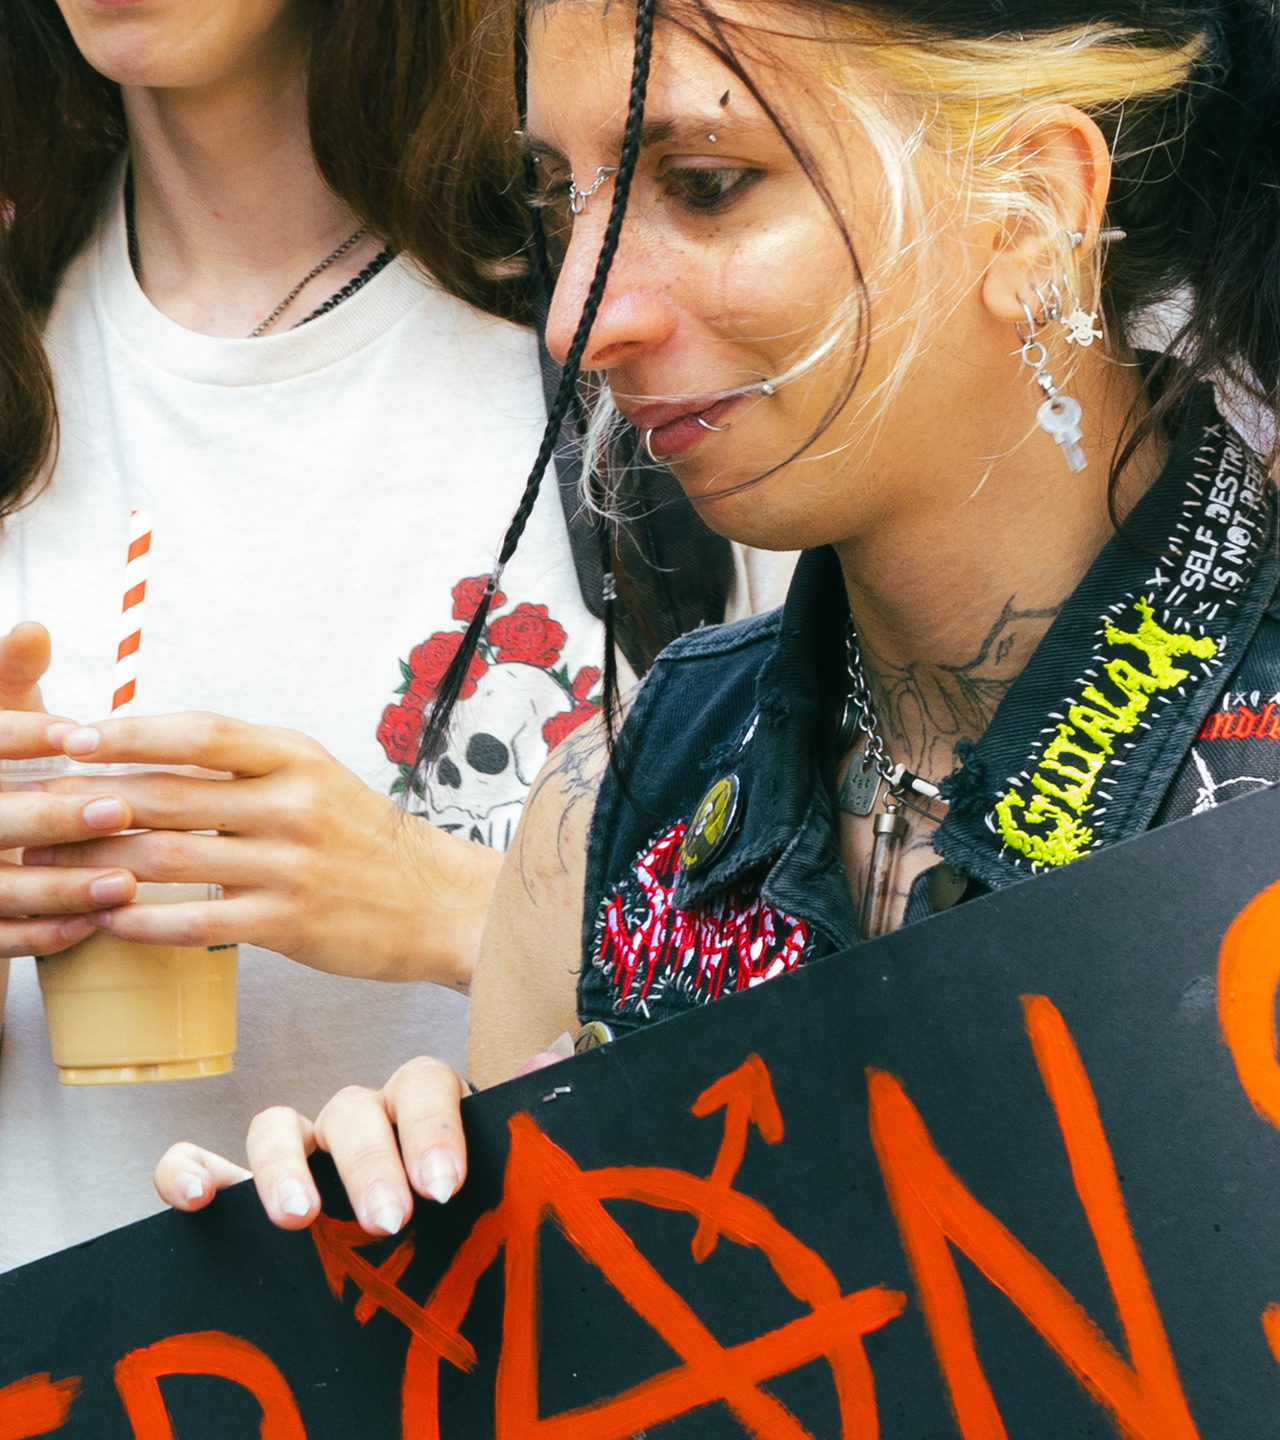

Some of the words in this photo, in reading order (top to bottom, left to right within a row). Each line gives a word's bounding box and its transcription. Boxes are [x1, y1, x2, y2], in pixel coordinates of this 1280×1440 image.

[1181, 525, 1219, 591] SELF
[1222, 511, 1255, 564] NOT
[1210, 566, 1244, 592] IS
